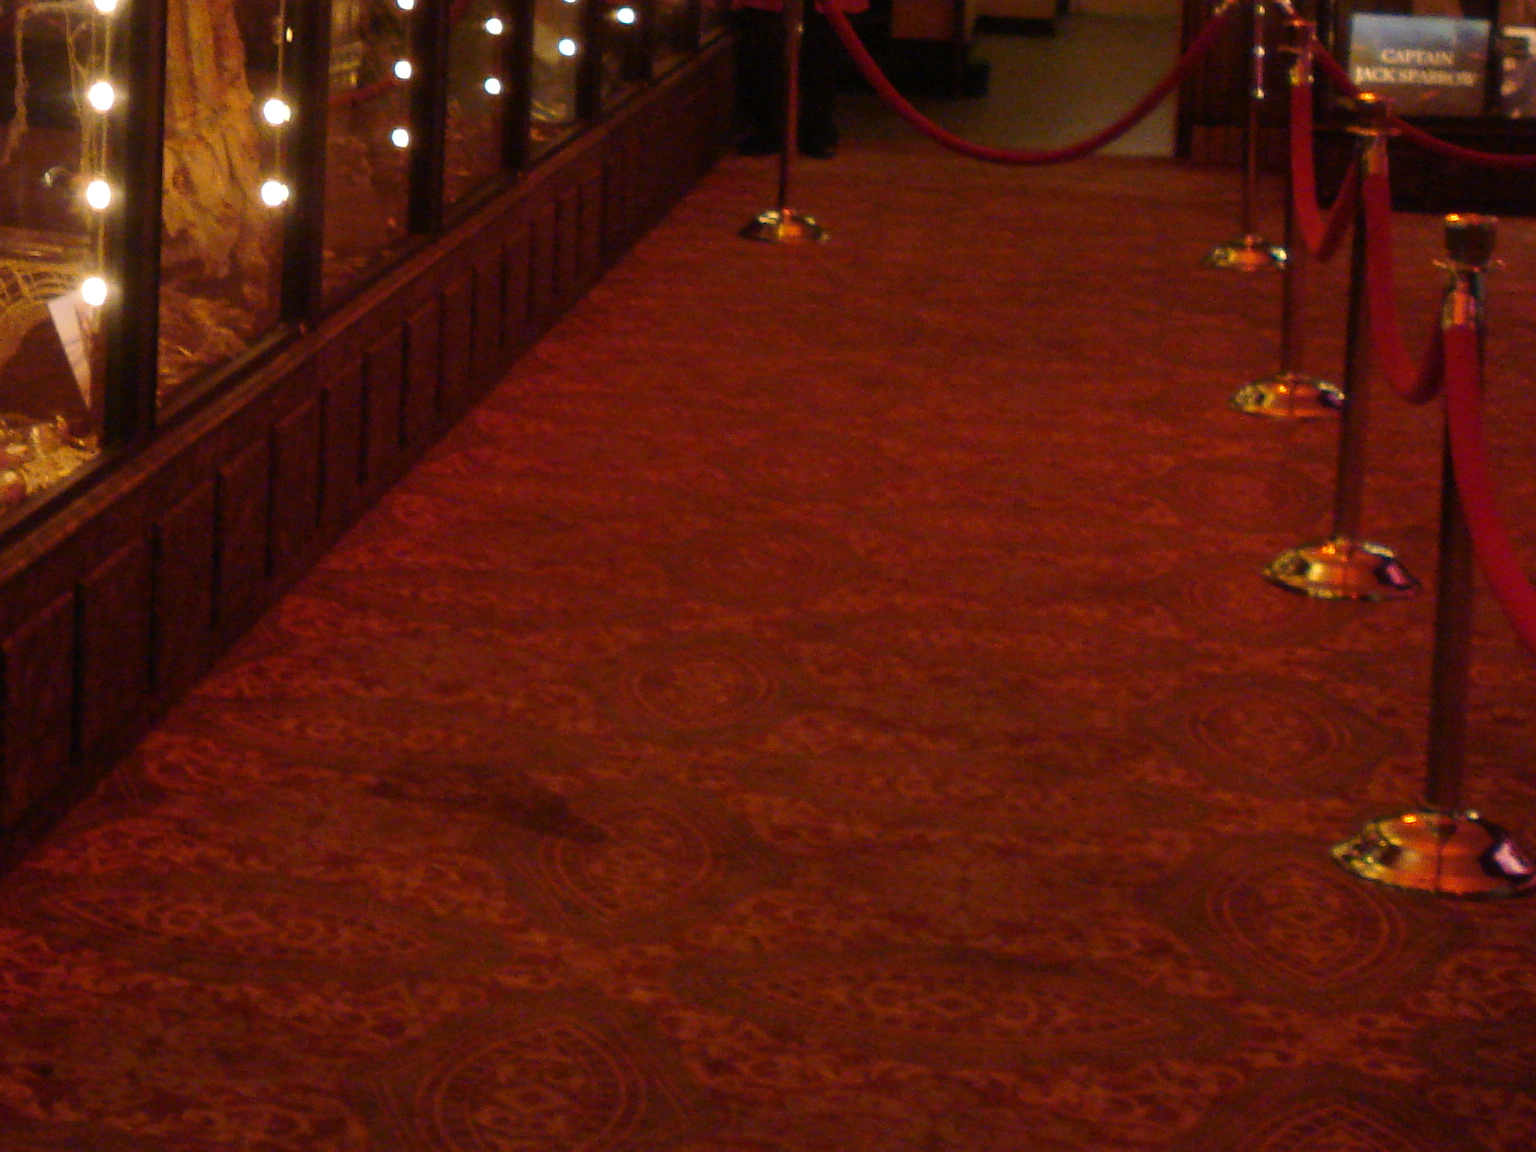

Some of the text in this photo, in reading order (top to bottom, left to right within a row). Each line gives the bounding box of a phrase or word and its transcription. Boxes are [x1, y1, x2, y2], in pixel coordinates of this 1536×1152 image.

[1381, 49, 1454, 65] CAPTAIN
[1354, 66, 1477, 86] JACK SPARROW
